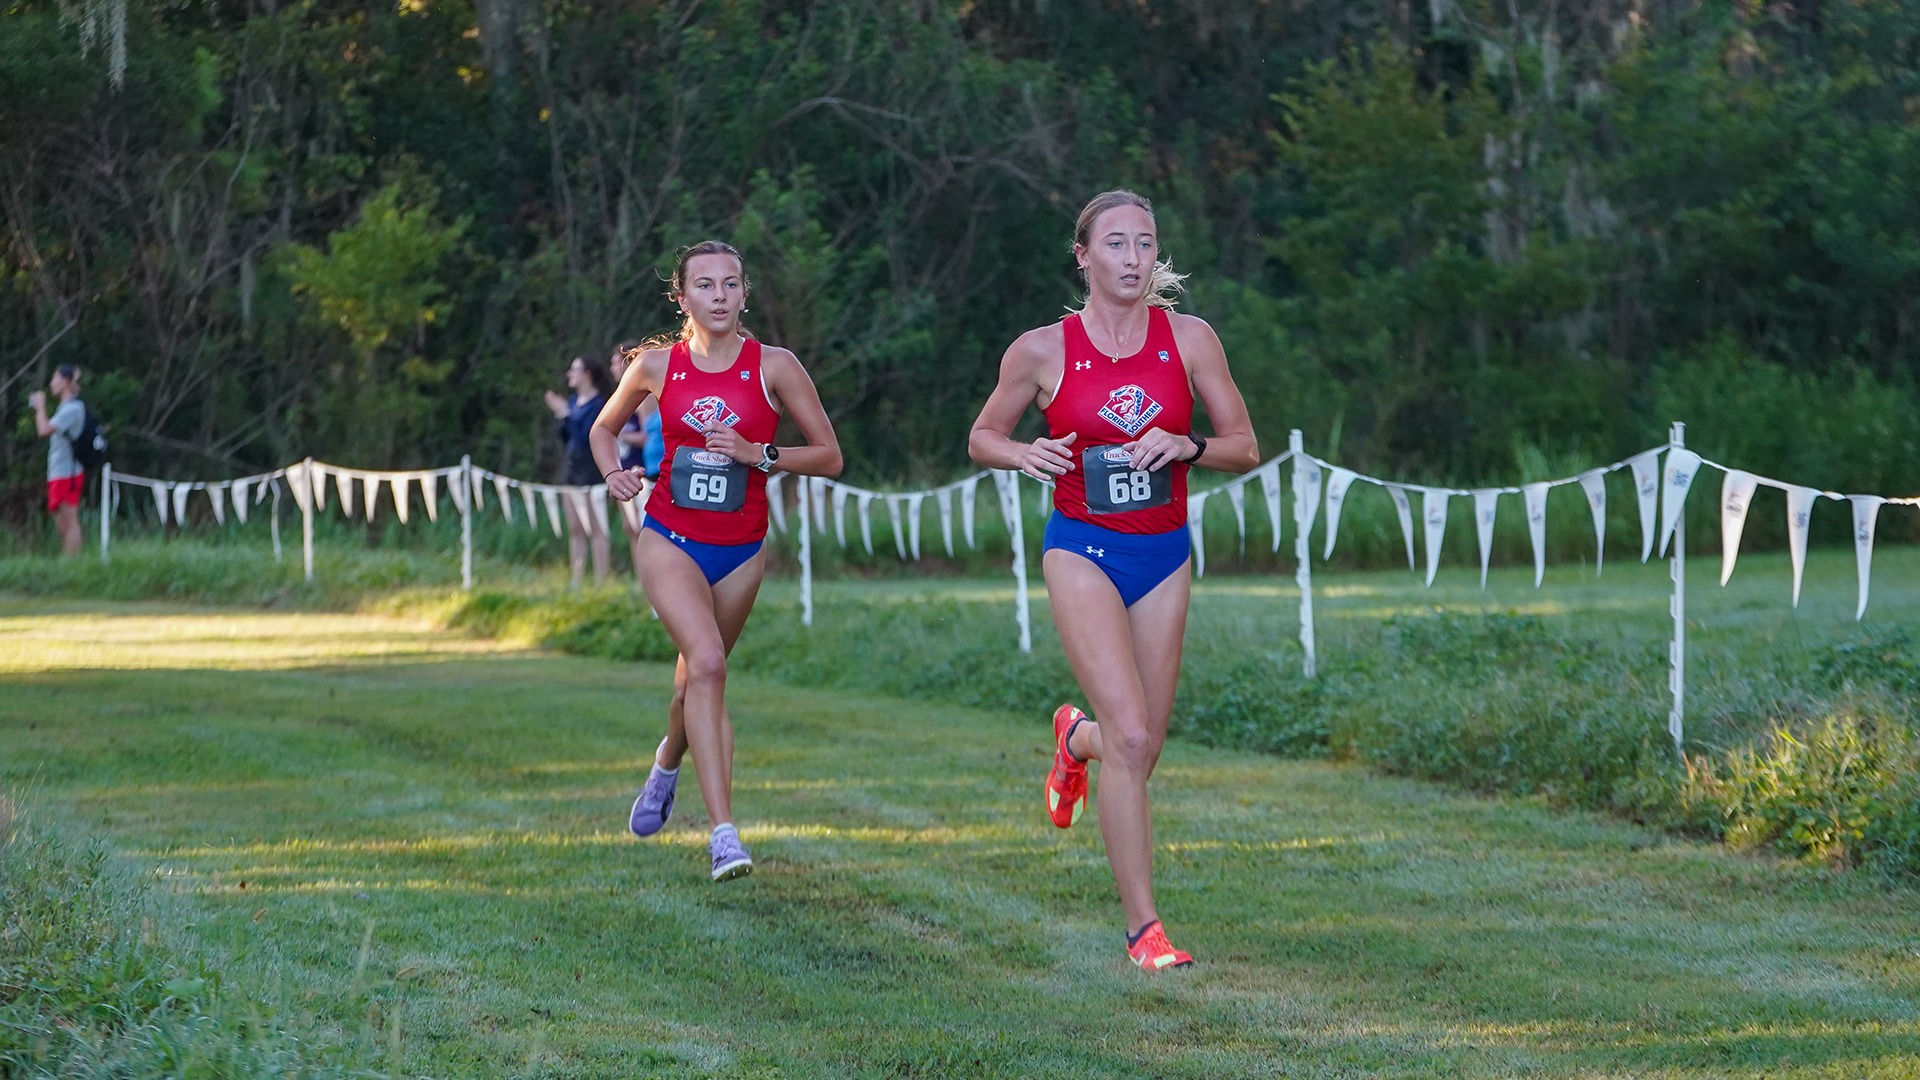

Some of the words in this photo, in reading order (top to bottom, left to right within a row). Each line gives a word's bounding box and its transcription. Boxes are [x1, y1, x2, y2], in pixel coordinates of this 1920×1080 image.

[1100, 407, 1128, 430] FLORIDA
[1128, 403, 1160, 434] SOUTHERN
[688, 472, 727, 503] 69
[1108, 469, 1151, 504] 68
